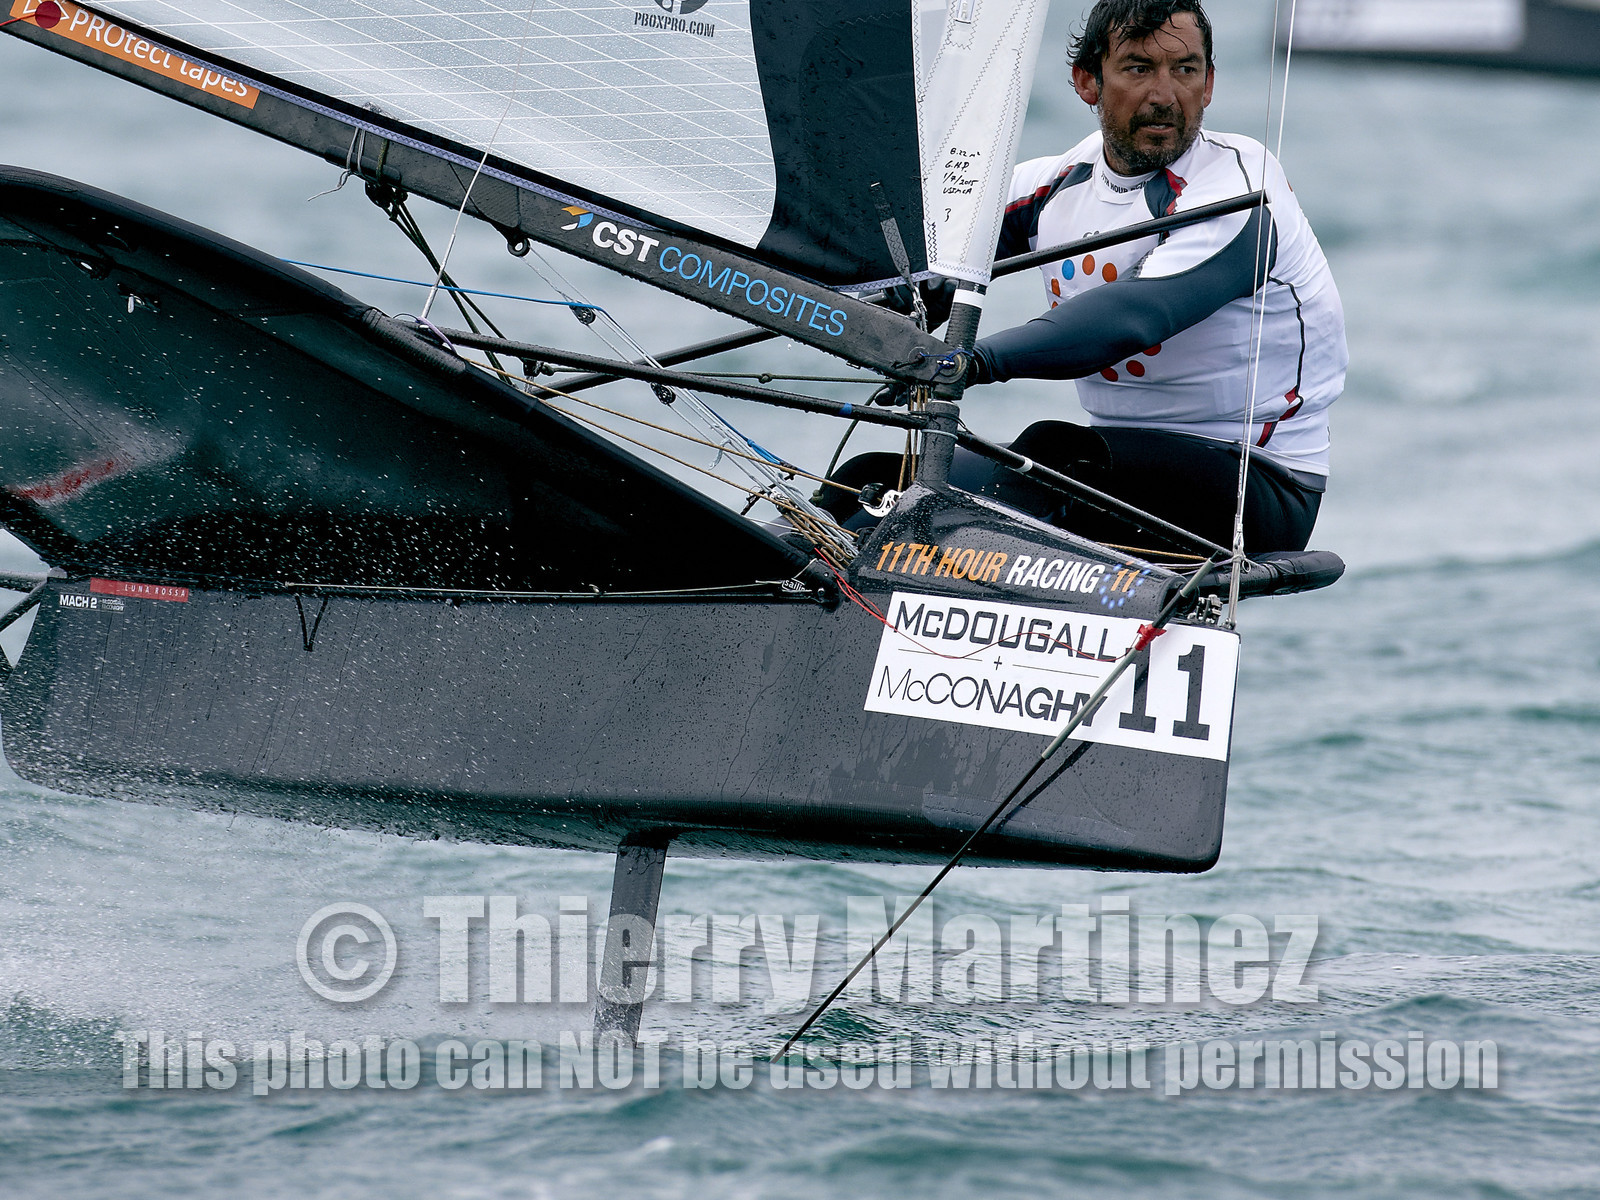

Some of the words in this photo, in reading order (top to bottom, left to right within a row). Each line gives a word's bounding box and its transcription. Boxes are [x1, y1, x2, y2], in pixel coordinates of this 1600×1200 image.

[634, 12, 716, 38] PBOXPRO.COM
[592, 221, 659, 263] CST
[659, 246, 848, 337] COMPOSITES
[124, 583, 150, 594] LUNA
[154, 587, 186, 597] ROSSA
[876, 541, 939, 576] 11TH
[935, 547, 1008, 583] HOUR
[1005, 555, 1106, 594] RACING
[59, 594, 89, 608] MACH
[90, 597, 98, 609] 2
[894, 601, 1117, 664] McDOUGALL
[1119, 637, 1210, 741] 11
